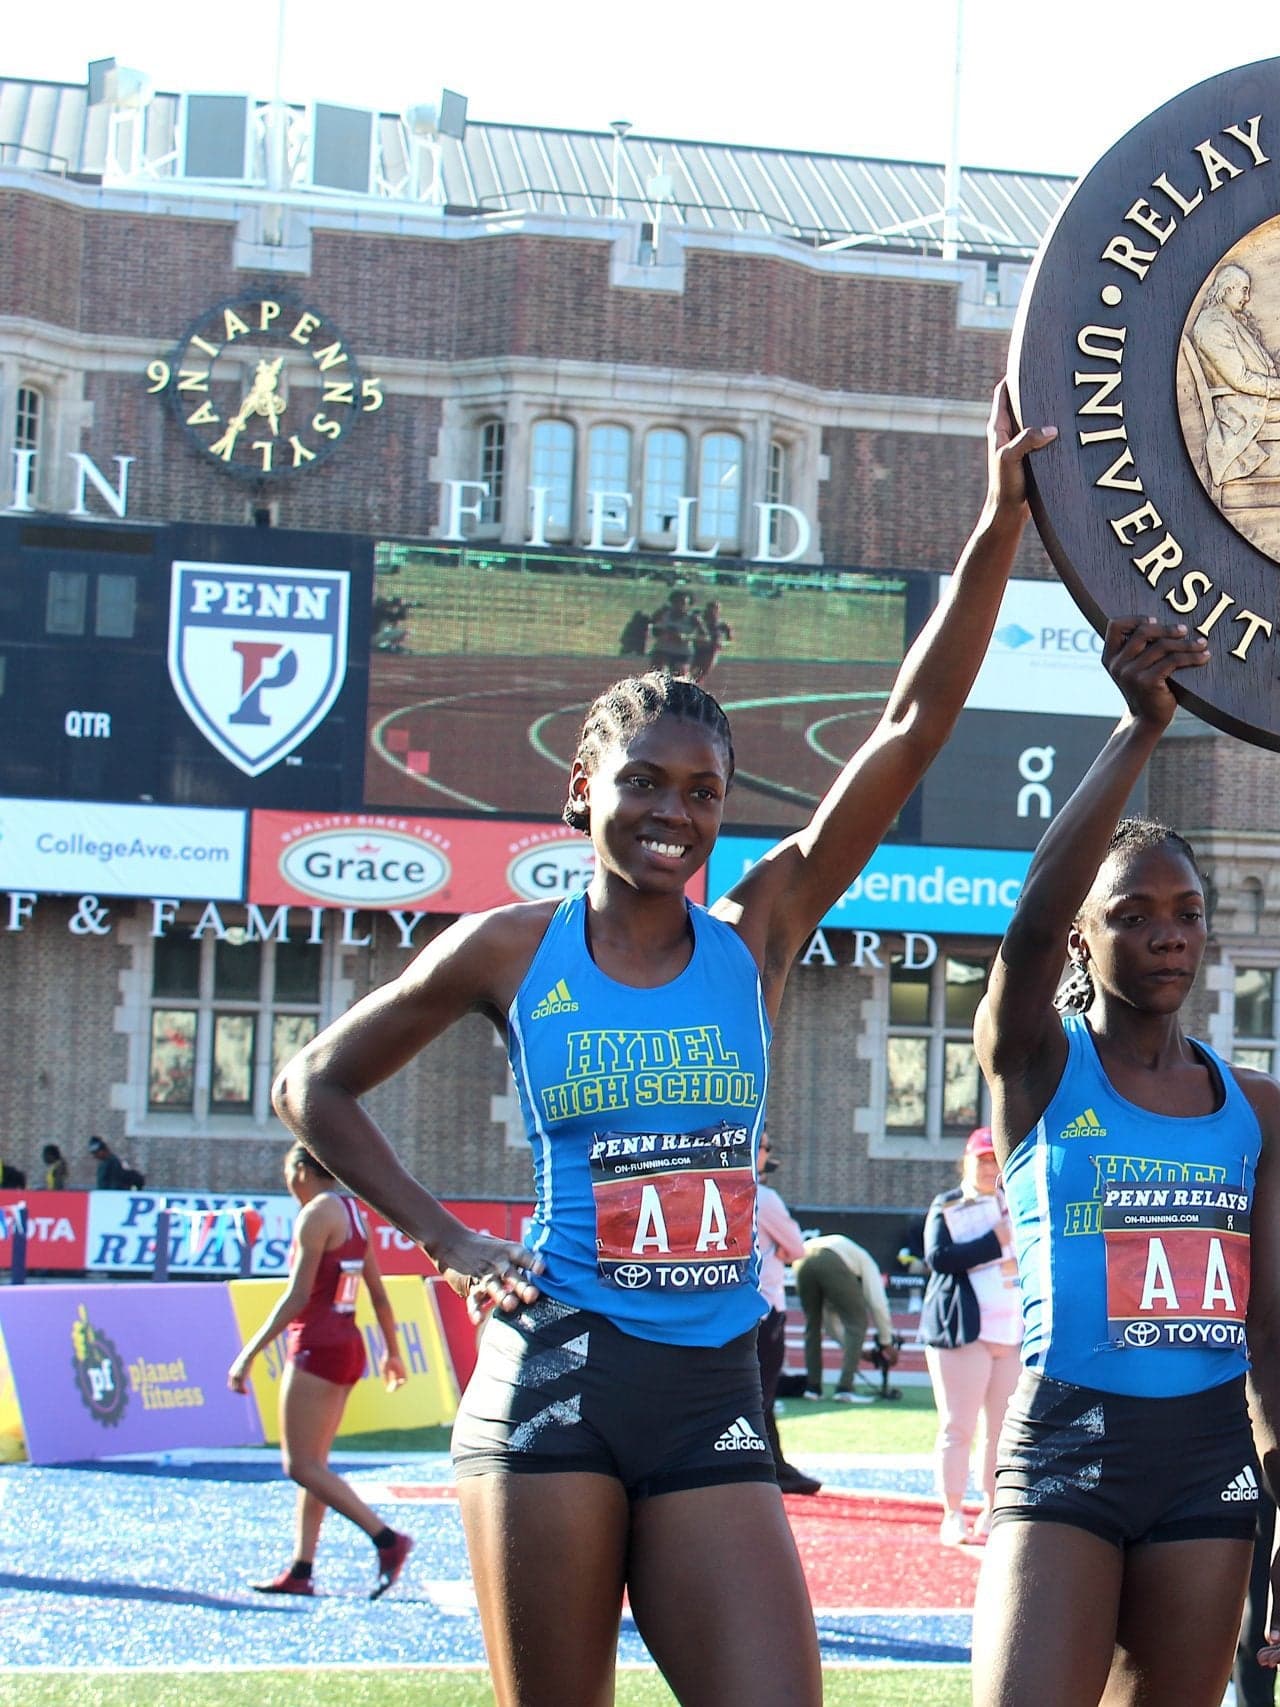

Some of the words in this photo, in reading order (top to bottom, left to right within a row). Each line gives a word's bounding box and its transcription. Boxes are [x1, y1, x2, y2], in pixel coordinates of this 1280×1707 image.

[1101, 114, 1271, 282] RELAY
[442, 479, 812, 564] FIELD
[190, 579, 331, 621] PENN
[65, 710, 112, 738] QTR
[36, 832, 230, 863] CollegeAve.com
[304, 850, 426, 885] Grace
[532, 861, 595, 891] Gra
[68, 895, 111, 935] &
[150, 899, 426, 949] FAMILY
[531, 1000, 579, 1020] adidas
[566, 1025, 739, 1080] HYDEL
[542, 1074, 628, 1121] HIGH
[635, 1072, 759, 1108] SCHOOL
[590, 1134, 657, 1160] PENN
[661, 1127, 747, 1152] RELAYS
[1060, 1126, 1107, 1140] adidas
[614, 1156, 692, 1174] ON-RUNNING.COM
[1104, 1189, 1172, 1207] PENN
[1172, 1189, 1249, 1212] RELAYS
[1124, 1214, 1199, 1224] ON-RUNNING.COM
[656, 1265, 741, 1288] TOYOTA
[1163, 1323, 1247, 1345] TOYOTA
[128, 1356, 187, 1392] planet
[141, 1385, 205, 1410] fitness
[714, 1435, 766, 1452] adidas
[1221, 1487, 1259, 1502] adida
